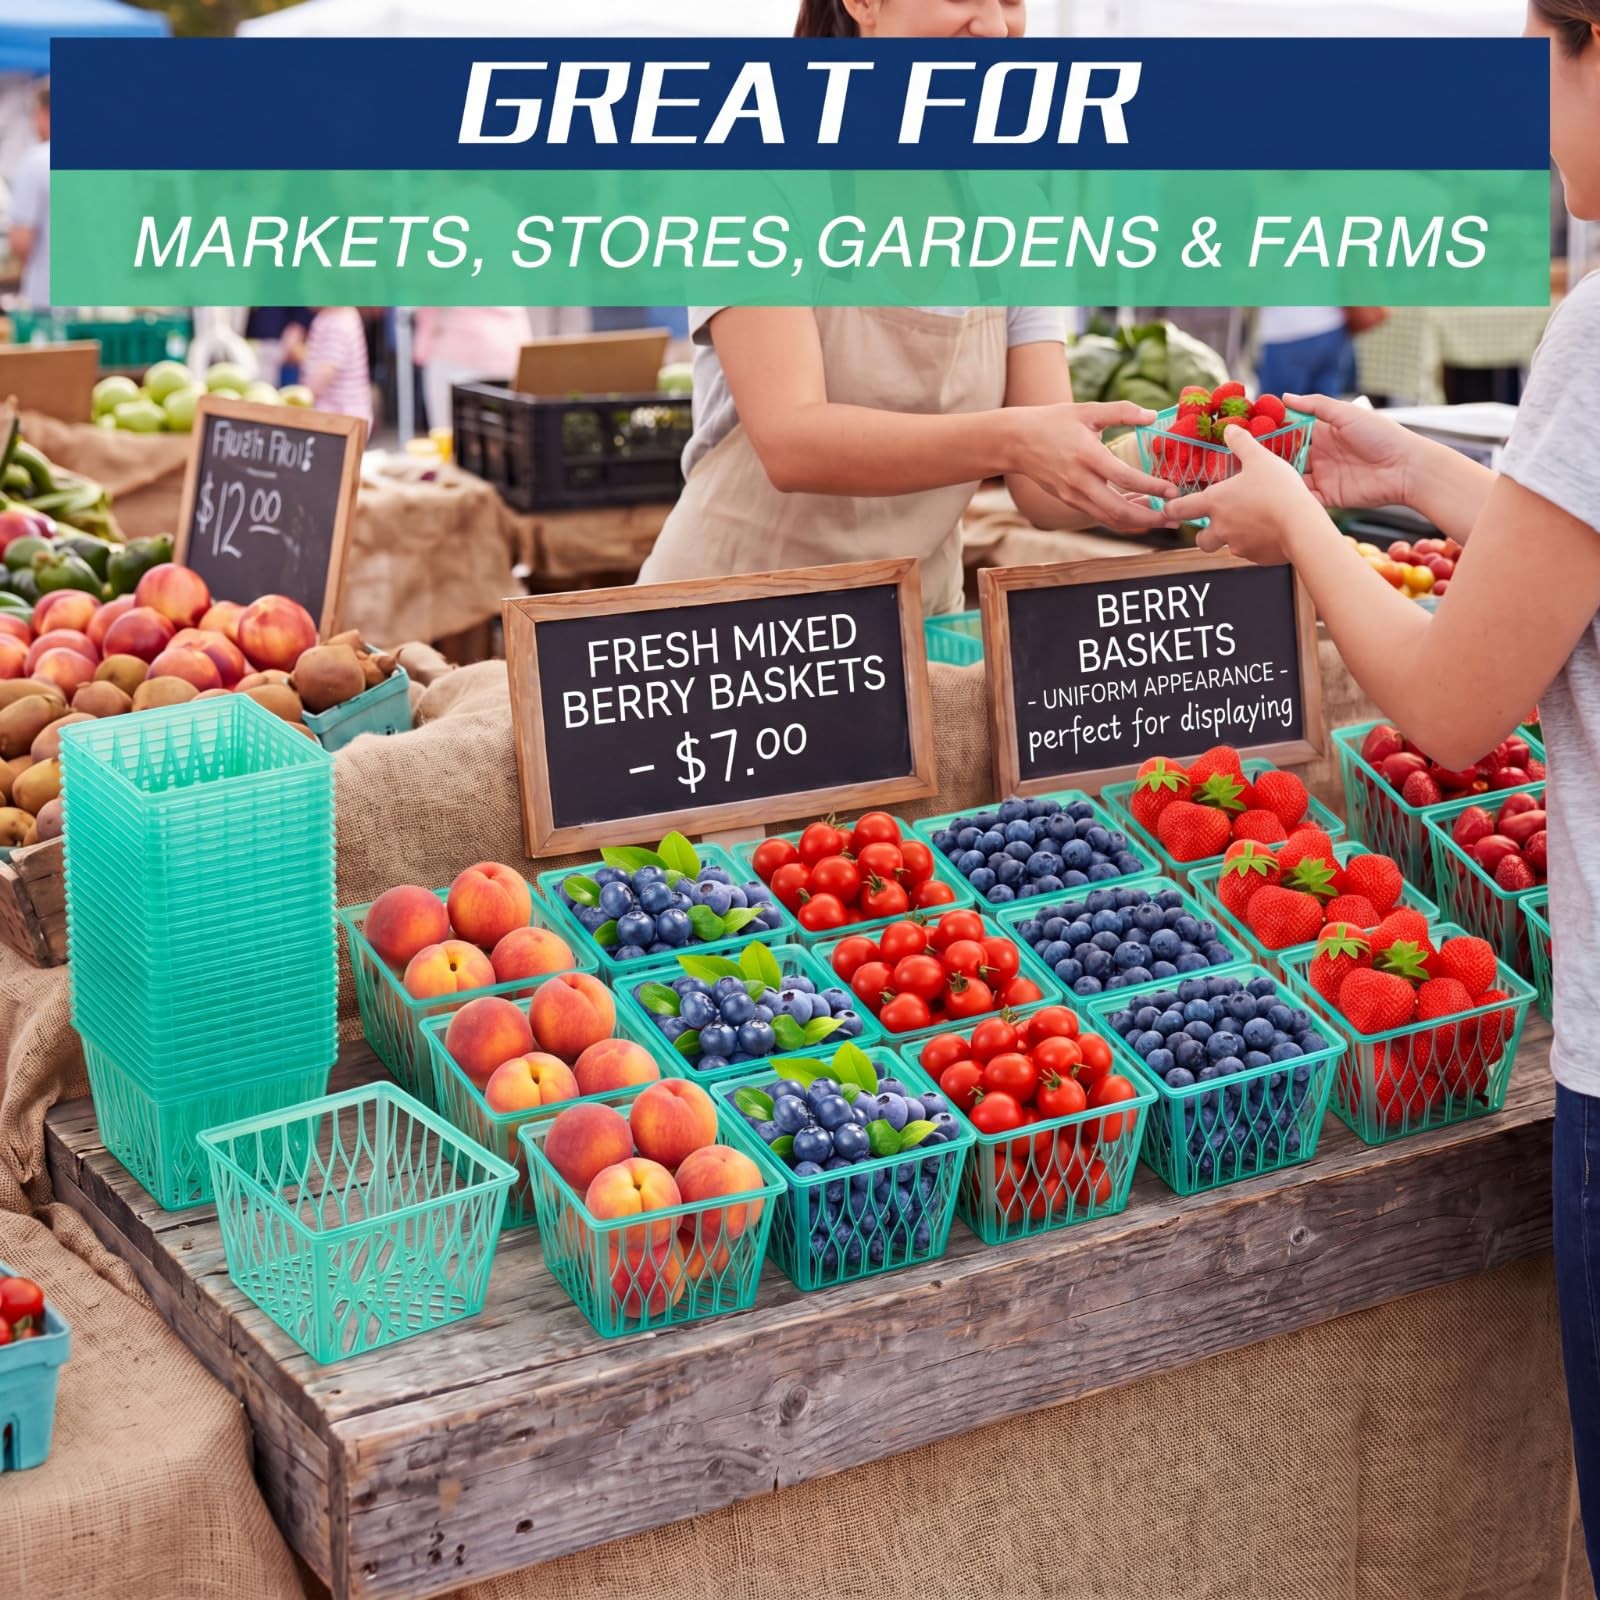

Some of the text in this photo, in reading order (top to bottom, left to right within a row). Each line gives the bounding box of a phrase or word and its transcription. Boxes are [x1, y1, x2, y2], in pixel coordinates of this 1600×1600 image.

[1097, 582, 1211, 628] BERRY
[587, 613, 857, 678] FRESH MIXED
[1078, 622, 1236, 673] BASKETS
[562, 655, 886, 729] BERRY BASKETS
[1043, 678, 1138, 710] UNIFORM
[1143, 661, 1275, 697] APPEARANCE
[676, 722, 807, 794] $7.00
[1028, 694, 1293, 763] perfect for displaying
